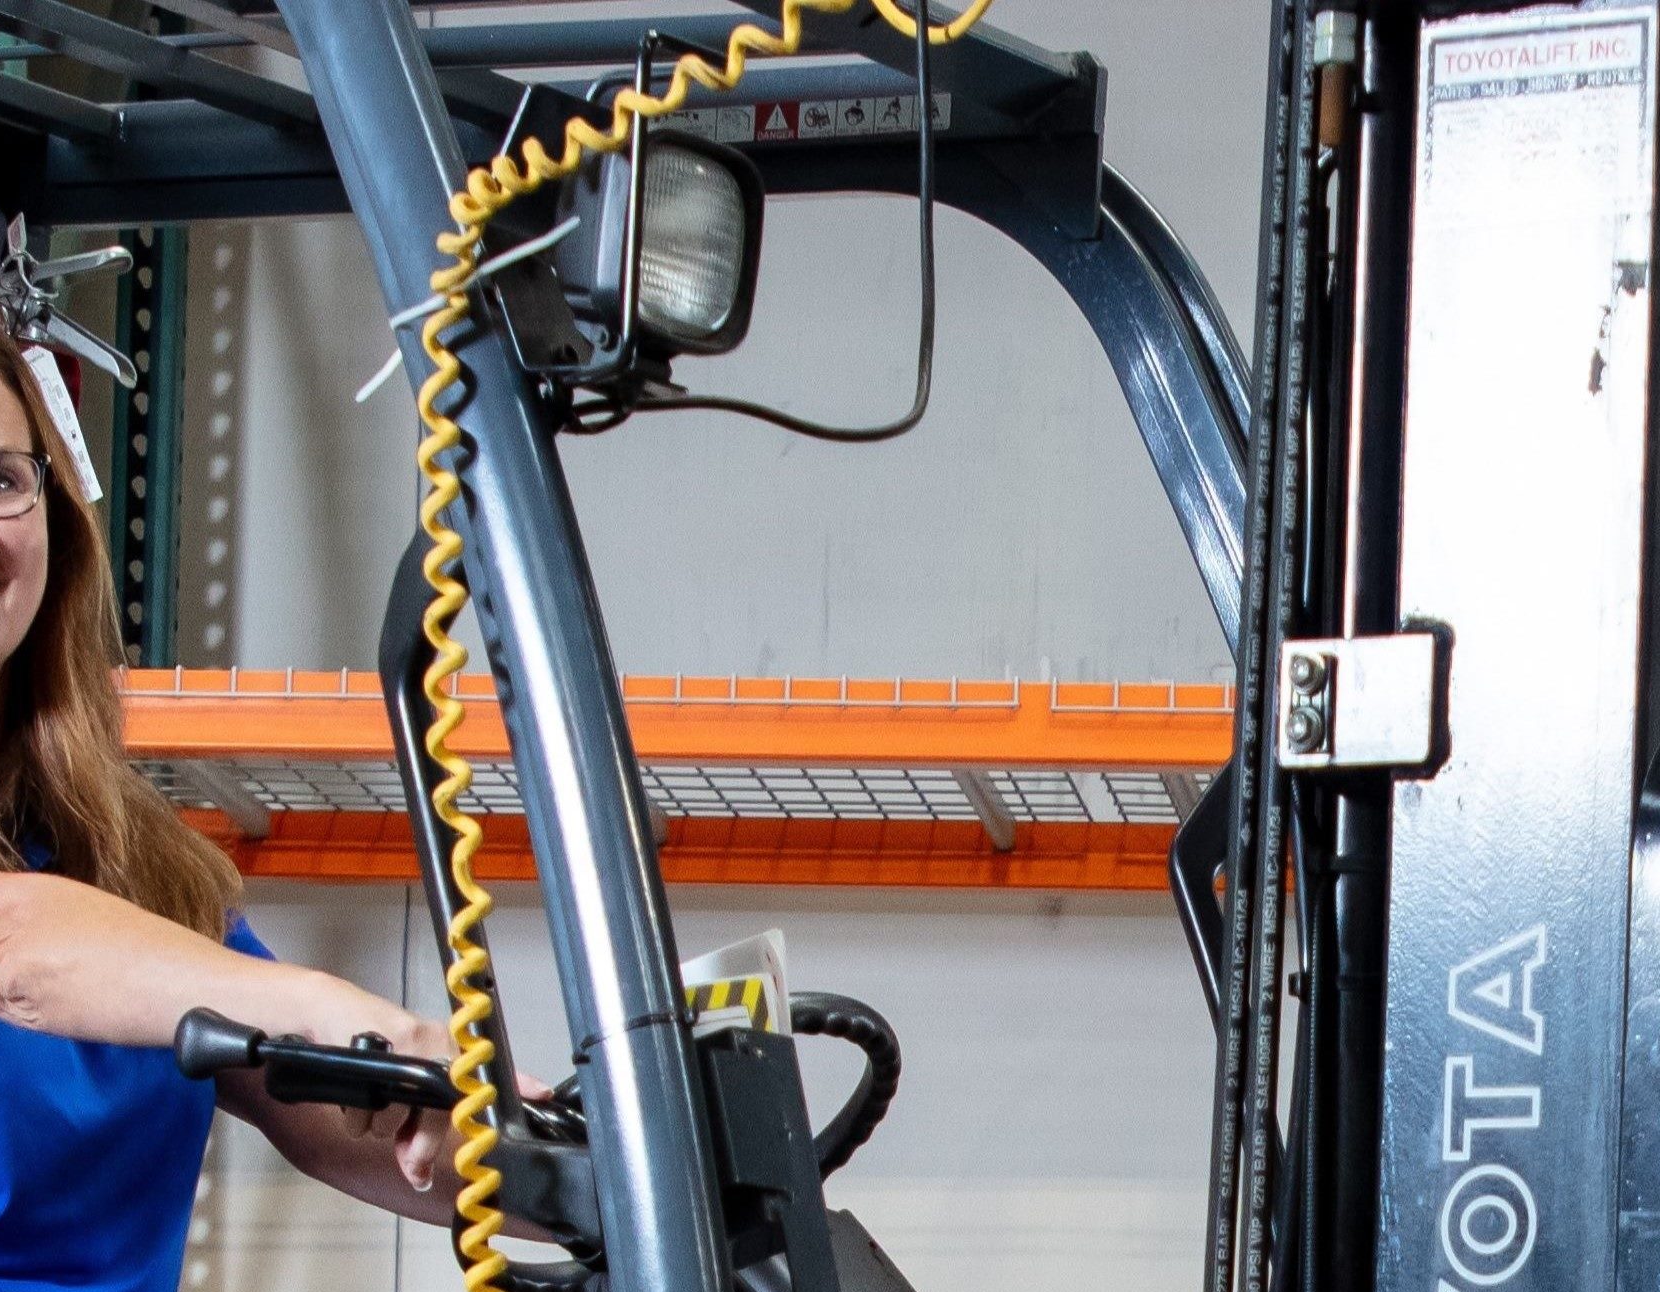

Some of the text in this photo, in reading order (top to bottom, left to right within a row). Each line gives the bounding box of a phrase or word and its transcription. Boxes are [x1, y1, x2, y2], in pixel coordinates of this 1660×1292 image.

[1433, 85, 1471, 100] PARTS
[1479, 80, 1518, 97] SALES
[756, 131, 795, 140] DANGER
[1263, 883, 1279, 935] MSHA
[1262, 942, 1276, 988] WIRE
[1230, 968, 1245, 1019] MSHA
[1227, 1027, 1241, 1073] WIRE
[1255, 1014, 1273, 1111] SAE100R16
[1250, 1216, 1263, 1245] WP
[1249, 1247, 1261, 1278] PSI
